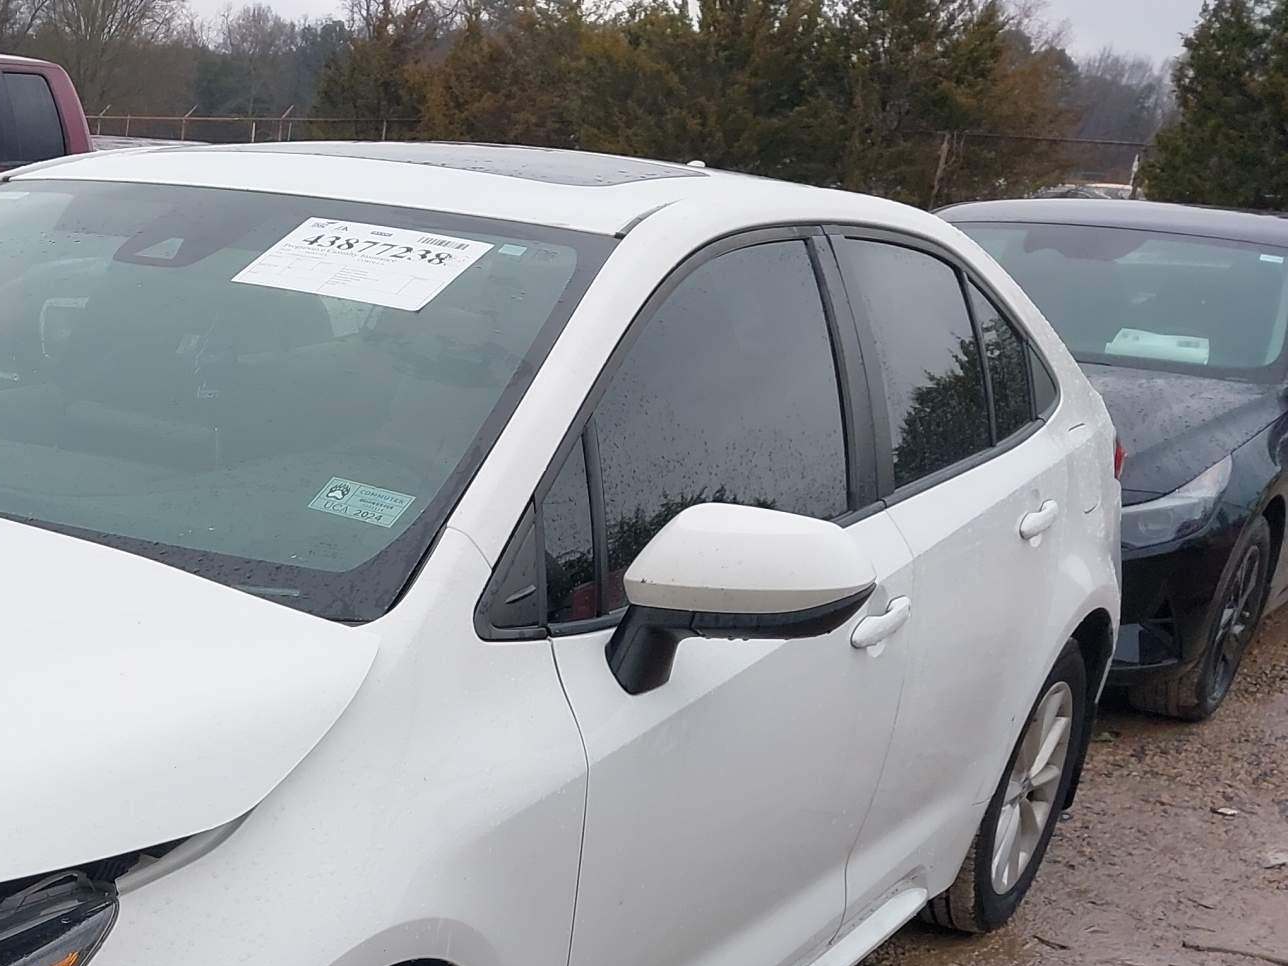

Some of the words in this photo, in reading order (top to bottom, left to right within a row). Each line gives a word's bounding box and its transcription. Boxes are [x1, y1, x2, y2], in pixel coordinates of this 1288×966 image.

[302, 233, 453, 266] 43877238
[323, 501, 350, 513] UCA
[353, 509, 383, 521] 2024
